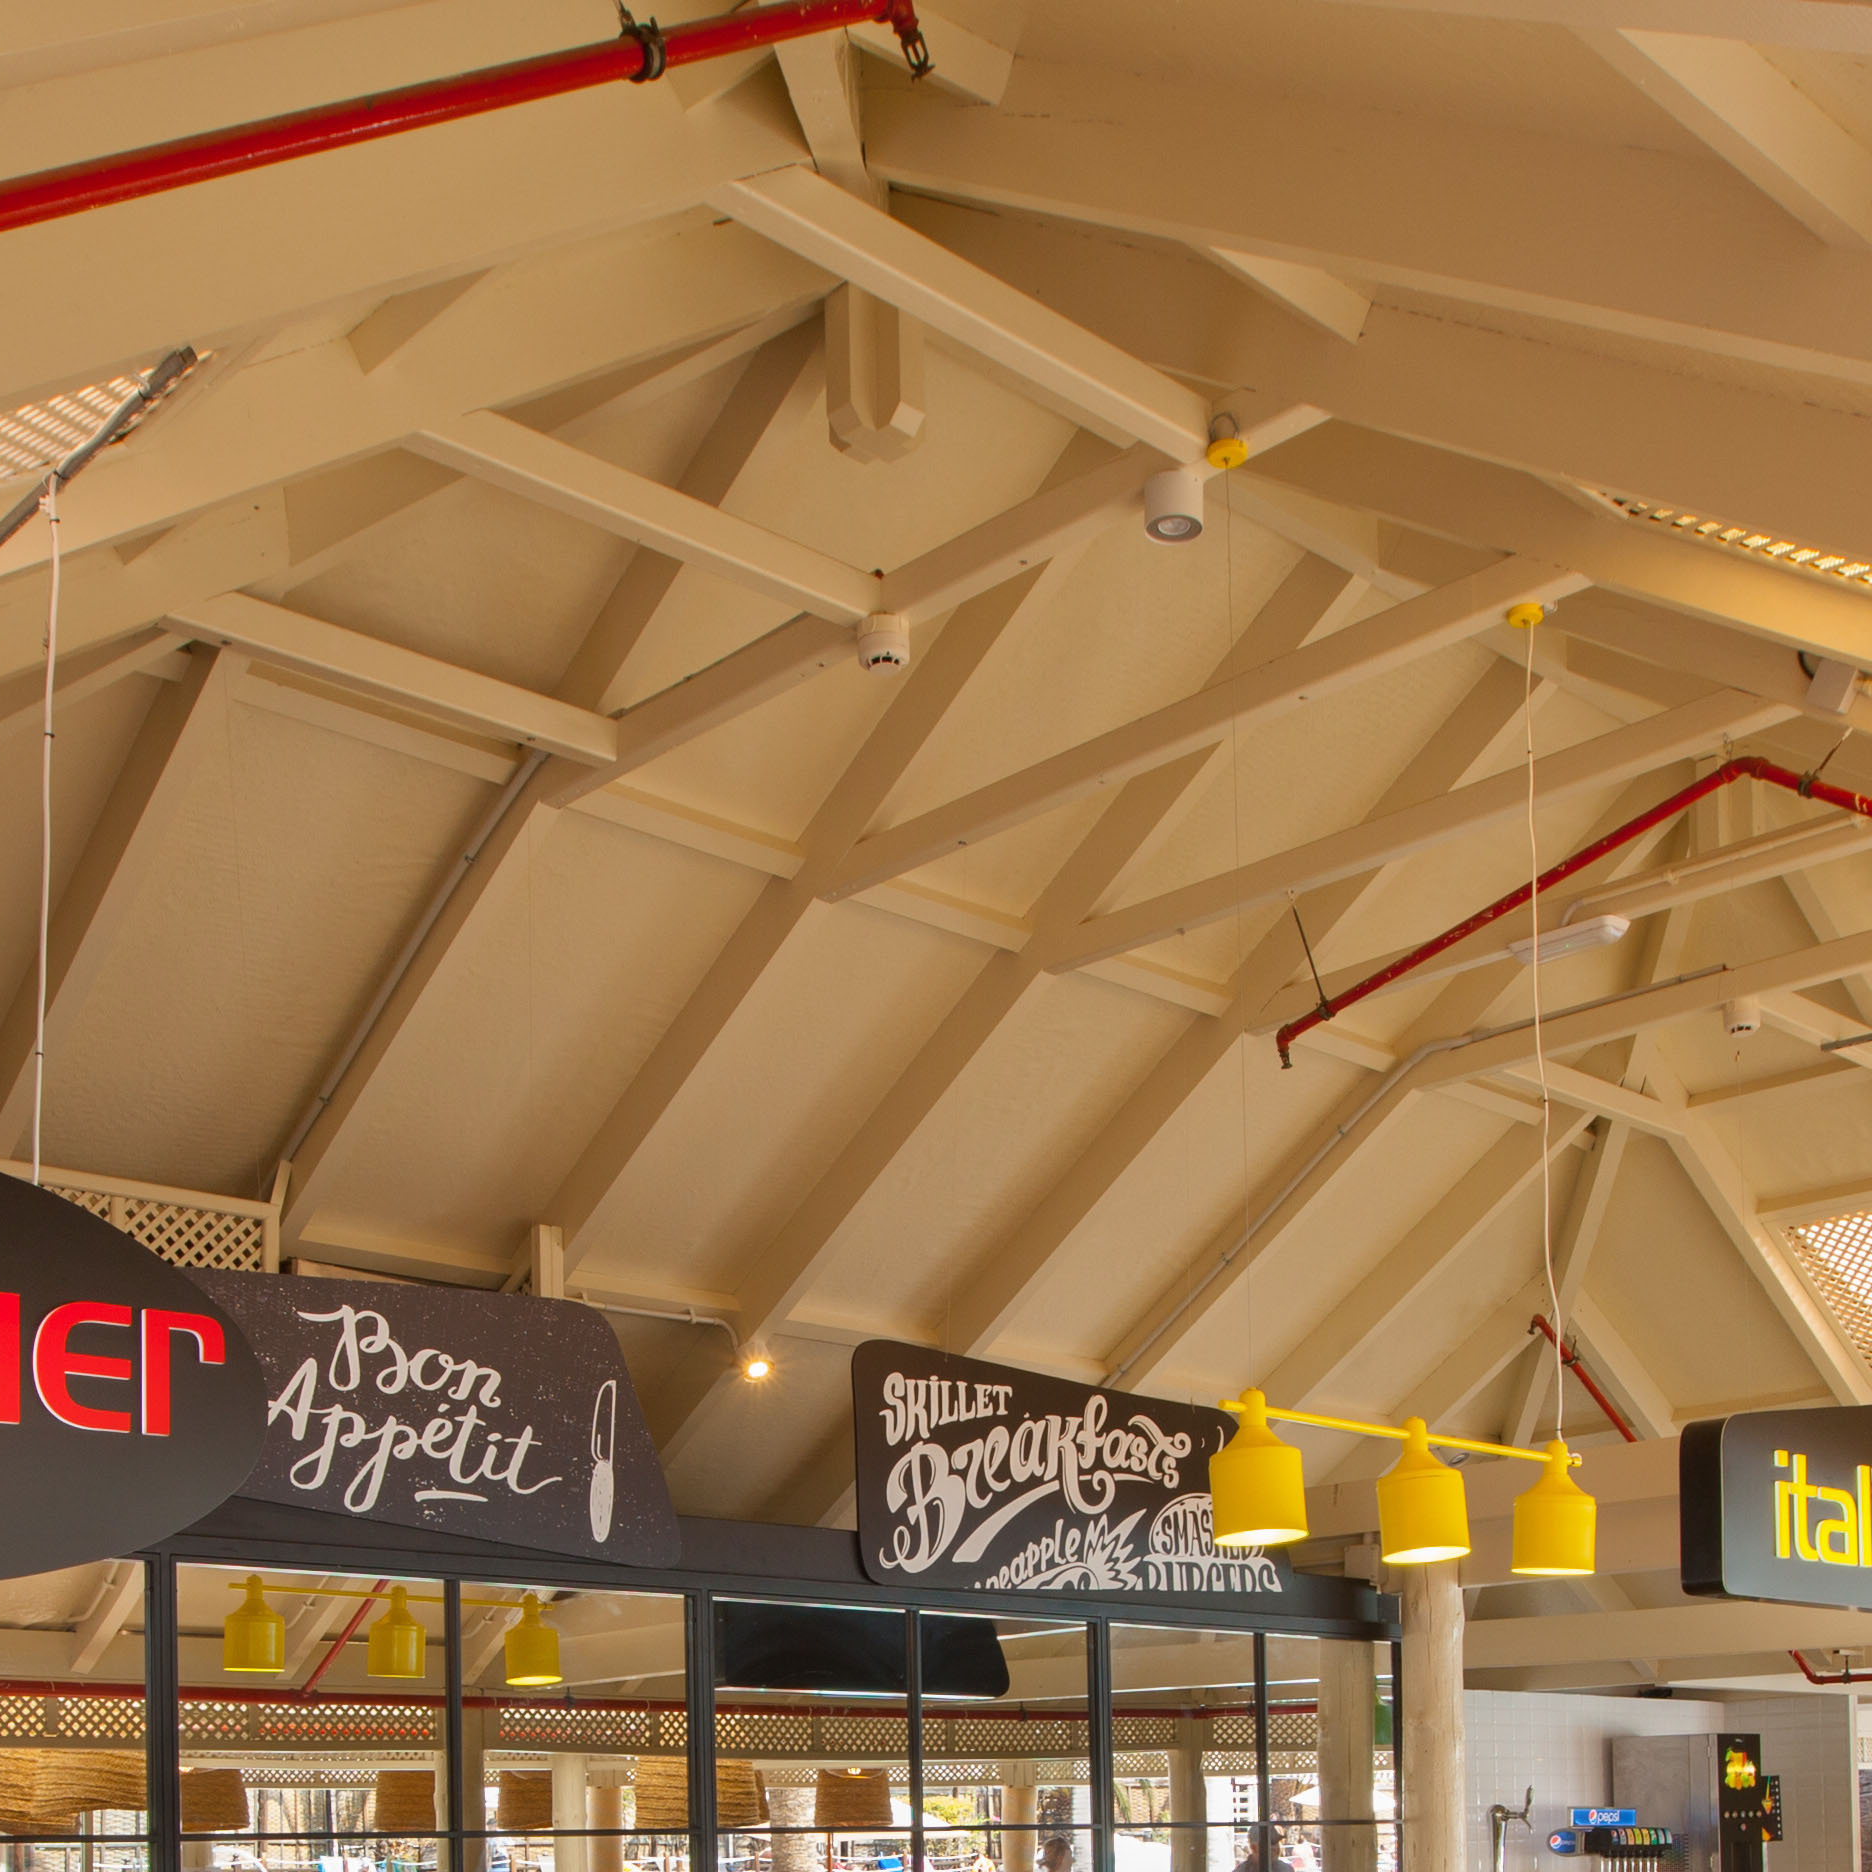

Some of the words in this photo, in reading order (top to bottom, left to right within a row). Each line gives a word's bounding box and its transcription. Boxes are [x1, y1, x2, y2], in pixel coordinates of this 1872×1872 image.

[297, 1304, 502, 1408] Bon
[267, 1357, 563, 1513] Appétit
[964, 1518, 1082, 1590] neapple
[1160, 1508, 1253, 1560] SMAS
[1596, 1809, 1620, 1824] pepsi
